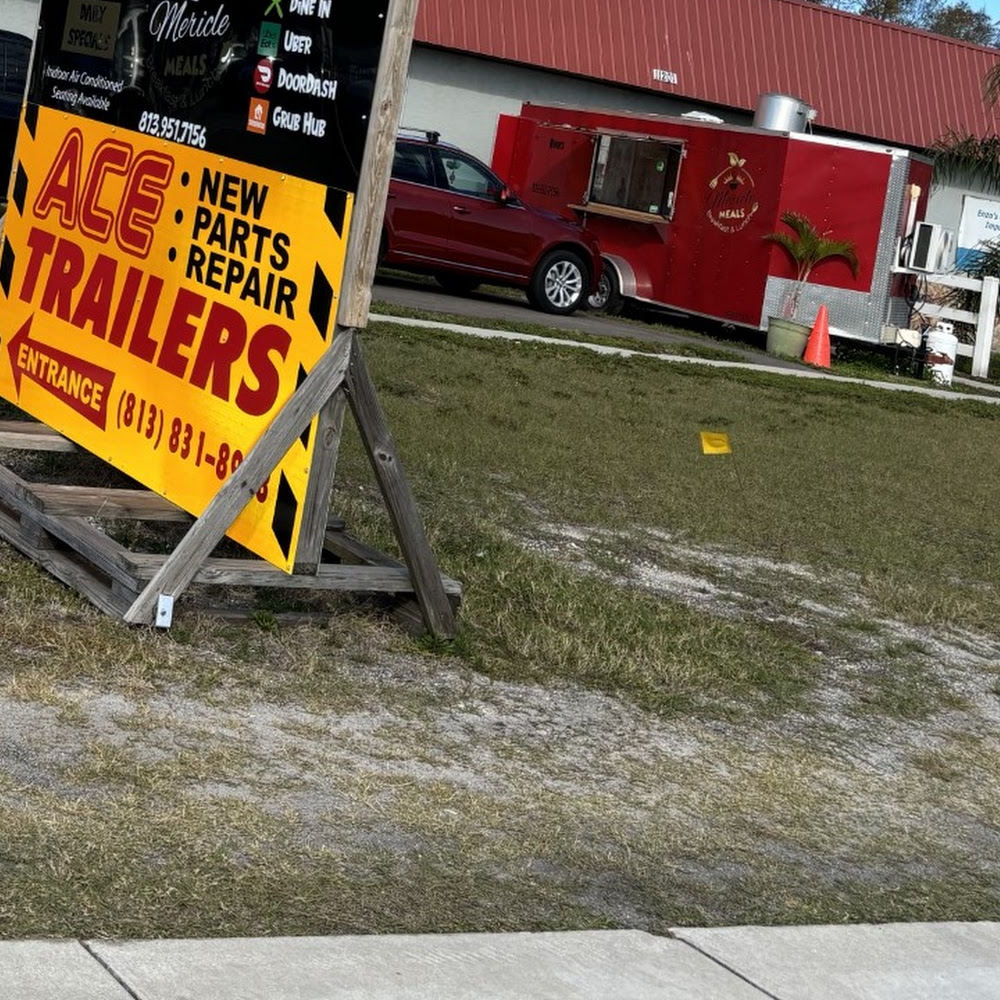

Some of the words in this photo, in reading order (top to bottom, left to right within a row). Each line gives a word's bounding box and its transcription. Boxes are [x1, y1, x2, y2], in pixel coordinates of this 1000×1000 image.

[149, 0, 231, 42] Mericle
[283, 29, 312, 55] UBER
[46, 65, 70, 81] Indoor
[69, 69, 80, 83] Air
[80, 72, 124, 93] Conditioned
[164, 54, 207, 77] MEALS
[277, 67, 338, 101] DOORDASH
[51, 85, 78, 106] Seating
[77, 92, 111, 112] Available
[138, 110, 207, 149] 813.951.7156
[273, 106, 301, 132] GRUB
[302, 112, 327, 138] HUB
[32, 127, 175, 260] ACE
[199, 167, 269, 220] NEW
[192, 206, 291, 272] PARTS
[185, 244, 298, 321] REPAIR
[19, 226, 292, 417] TRAILERS
[16, 343, 105, 412] ENTRANCE
[117, 389, 164, 450] (813)
